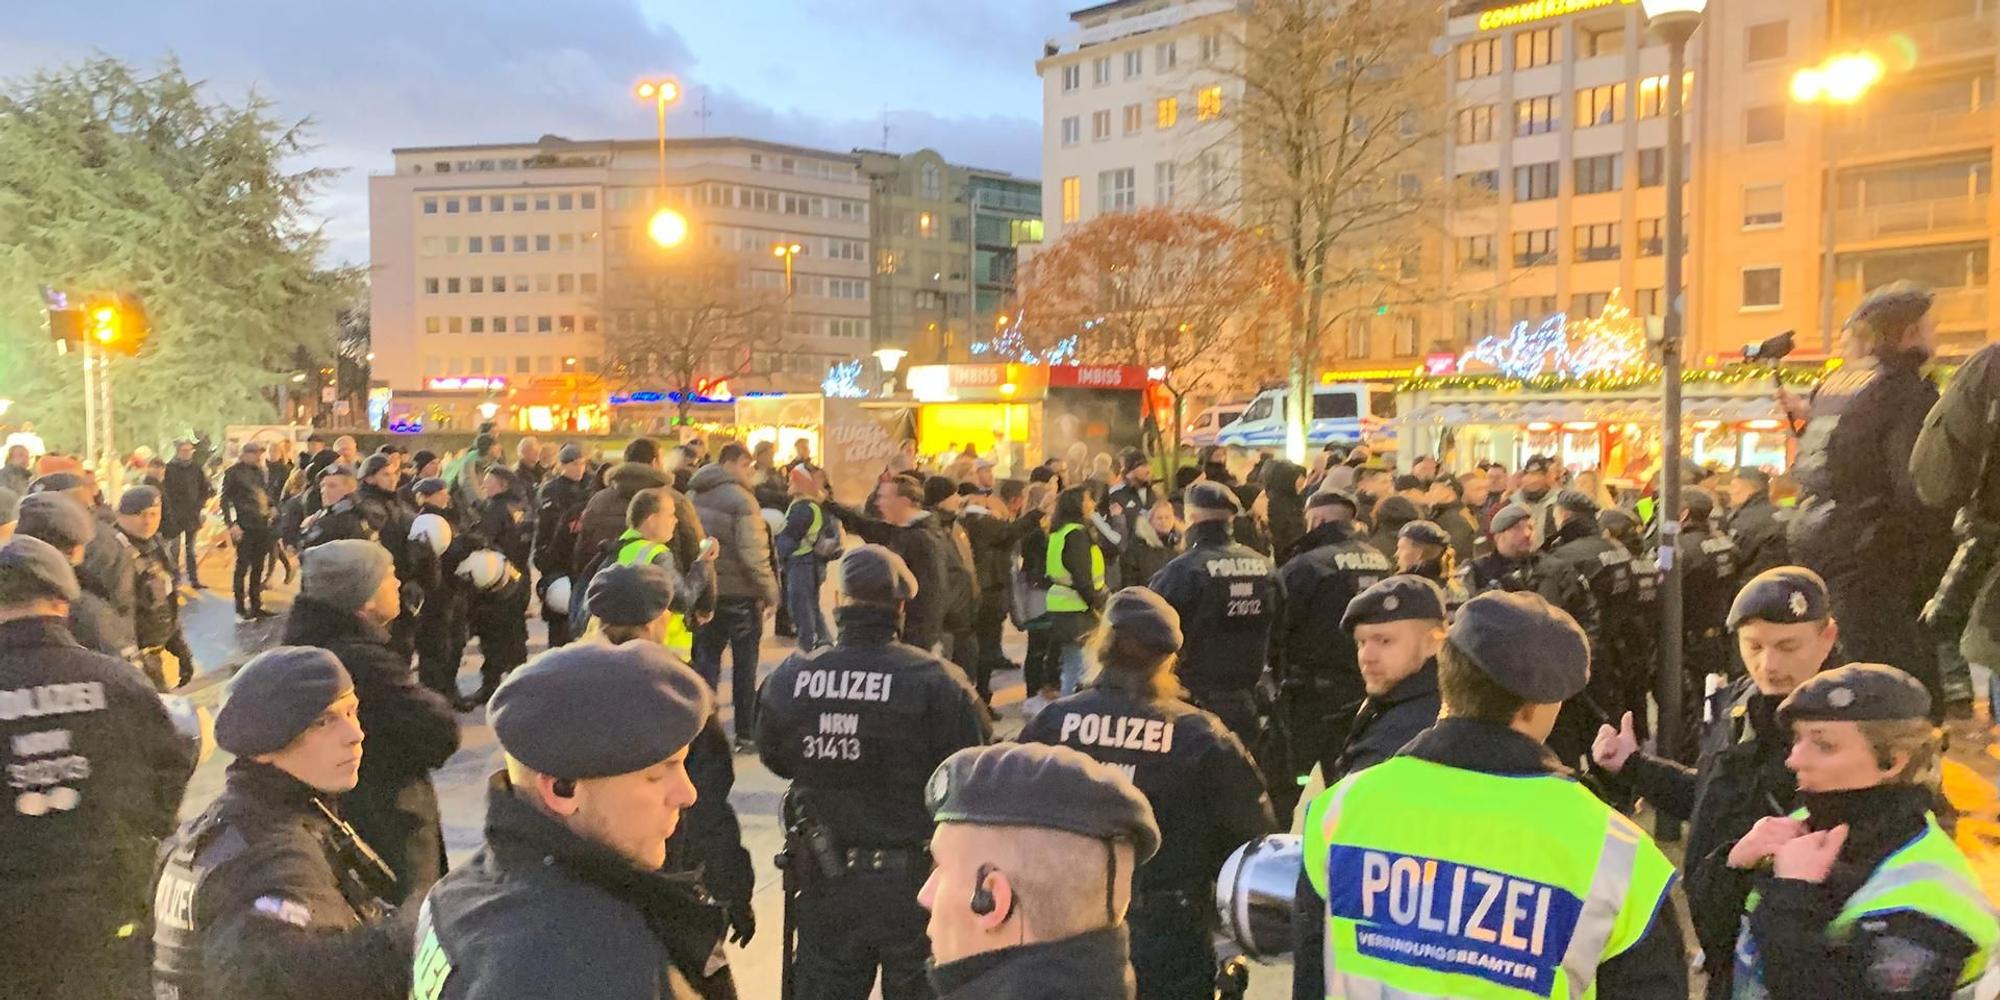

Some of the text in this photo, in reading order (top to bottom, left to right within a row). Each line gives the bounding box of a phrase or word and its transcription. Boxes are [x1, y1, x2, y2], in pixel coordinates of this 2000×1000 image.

[1479, 0, 1614, 31] COMMERZBA
[954, 367, 998, 385] IMBISS
[1078, 365, 1122, 386] IMBISS
[793, 669, 893, 702] POLIZEI
[819, 712, 859, 735] NRW
[1060, 712, 1175, 754] POLIZEI
[802, 735, 861, 760] 31413
[1361, 850, 1553, 958] POLIZEI
